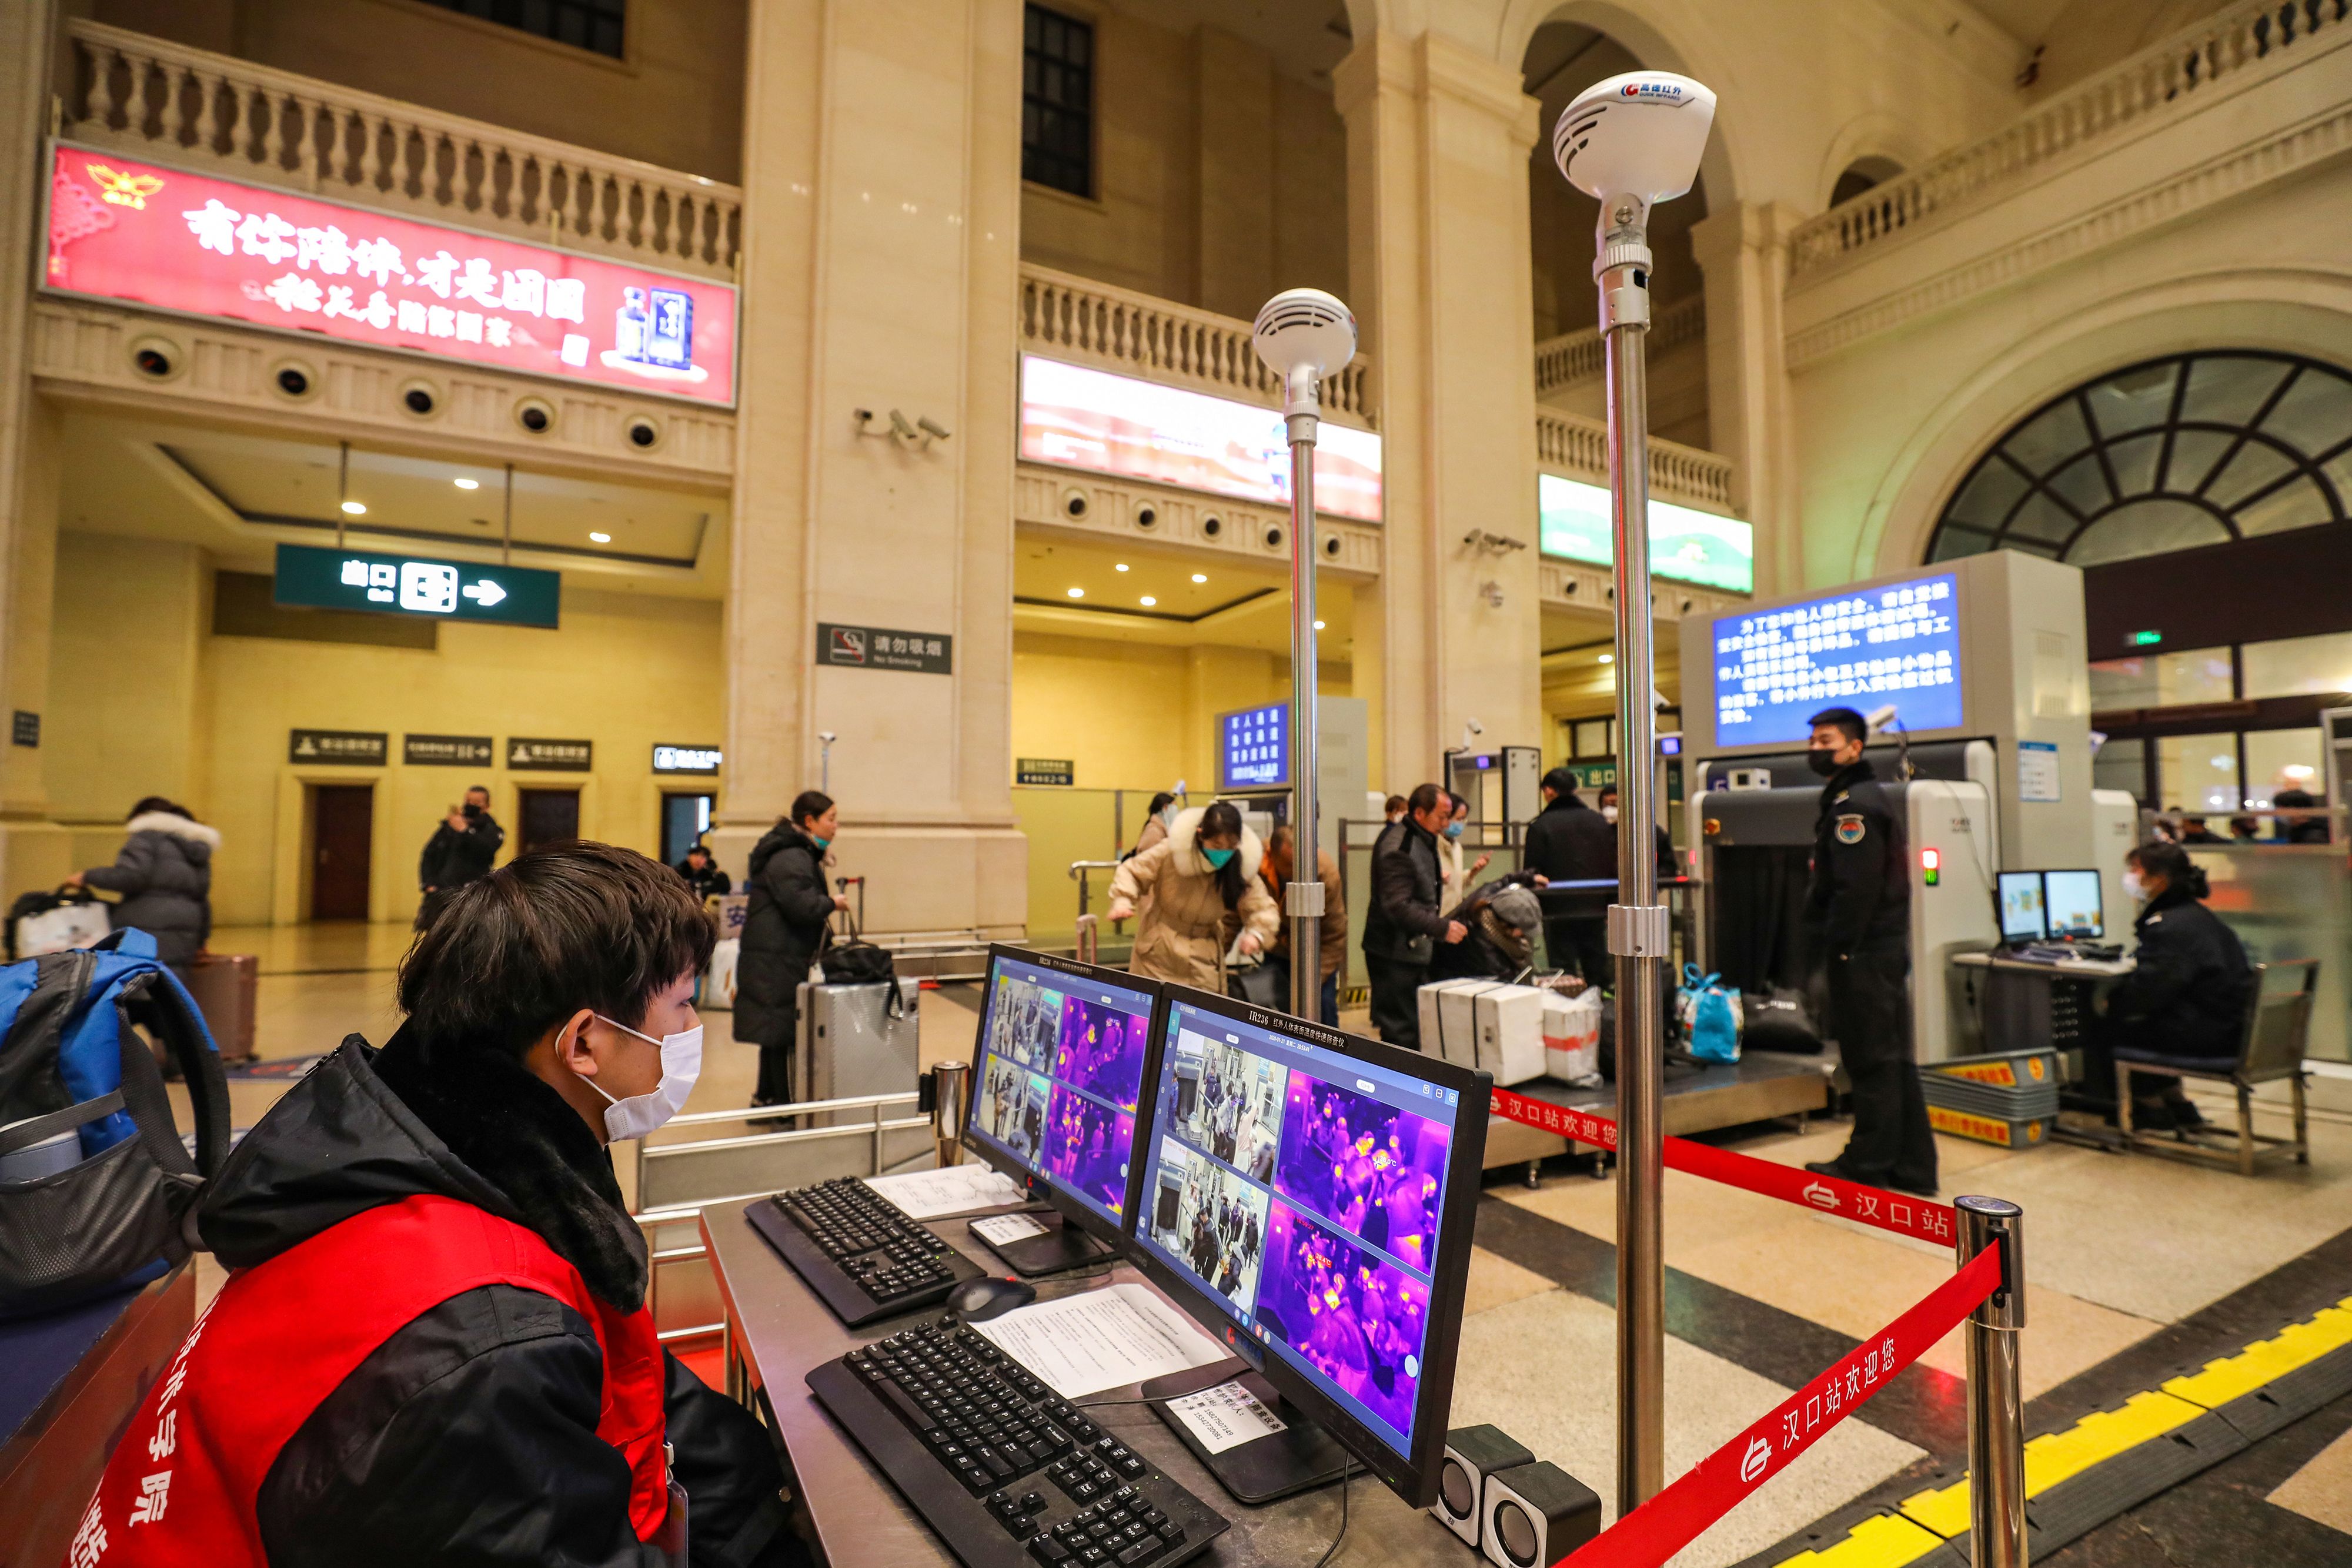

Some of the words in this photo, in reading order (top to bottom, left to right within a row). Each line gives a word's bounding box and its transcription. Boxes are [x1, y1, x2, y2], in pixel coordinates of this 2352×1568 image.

[1641, 83, 1681, 95] 高德红外
[874, 636, 942, 657] 请勿吸烟
[874, 655, 884, 663] No
[887, 656, 923, 668] Smoking
[1249, 1010, 1268, 1025] IR236
[1272, 1018, 1345, 1048] 红外人体表面温度快速筛查仪
[1269, 1035, 1285, 1044] 2020-01-21
[1509, 1098, 1616, 1146] 汉口站欢迎您
[1856, 1192, 1948, 1238] 汉口站
[1228, 1383, 1281, 1430] 红体筛查设备
[1782, 1337, 1895, 1450] 汉口站欢迎您
[1193, 1412, 1223, 1440] 15342730081
[1204, 1409, 1234, 1436] 15827507149
